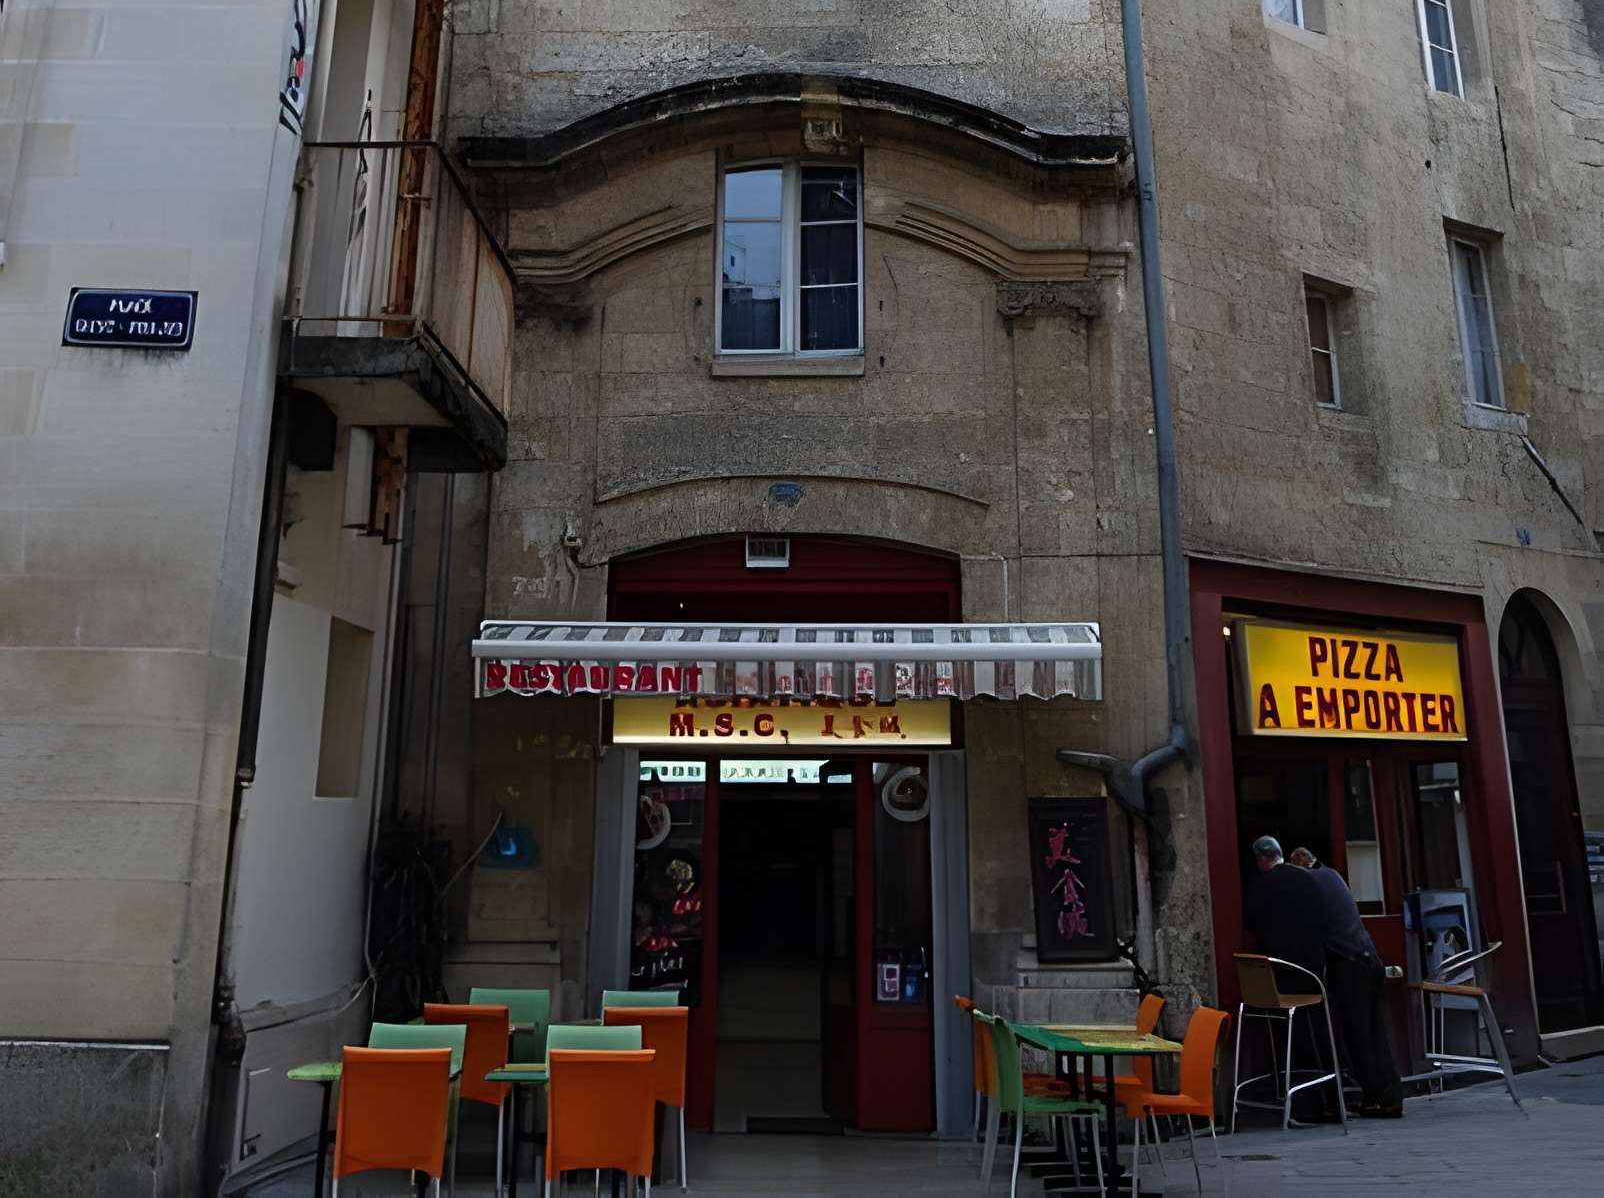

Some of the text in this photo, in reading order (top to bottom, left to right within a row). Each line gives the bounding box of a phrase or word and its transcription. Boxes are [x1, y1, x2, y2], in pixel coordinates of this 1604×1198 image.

[486, 660, 702, 693] RESTAURANT
[1308, 636, 1404, 683] PIZZA
[1258, 683, 1459, 734] A EMPORTER
